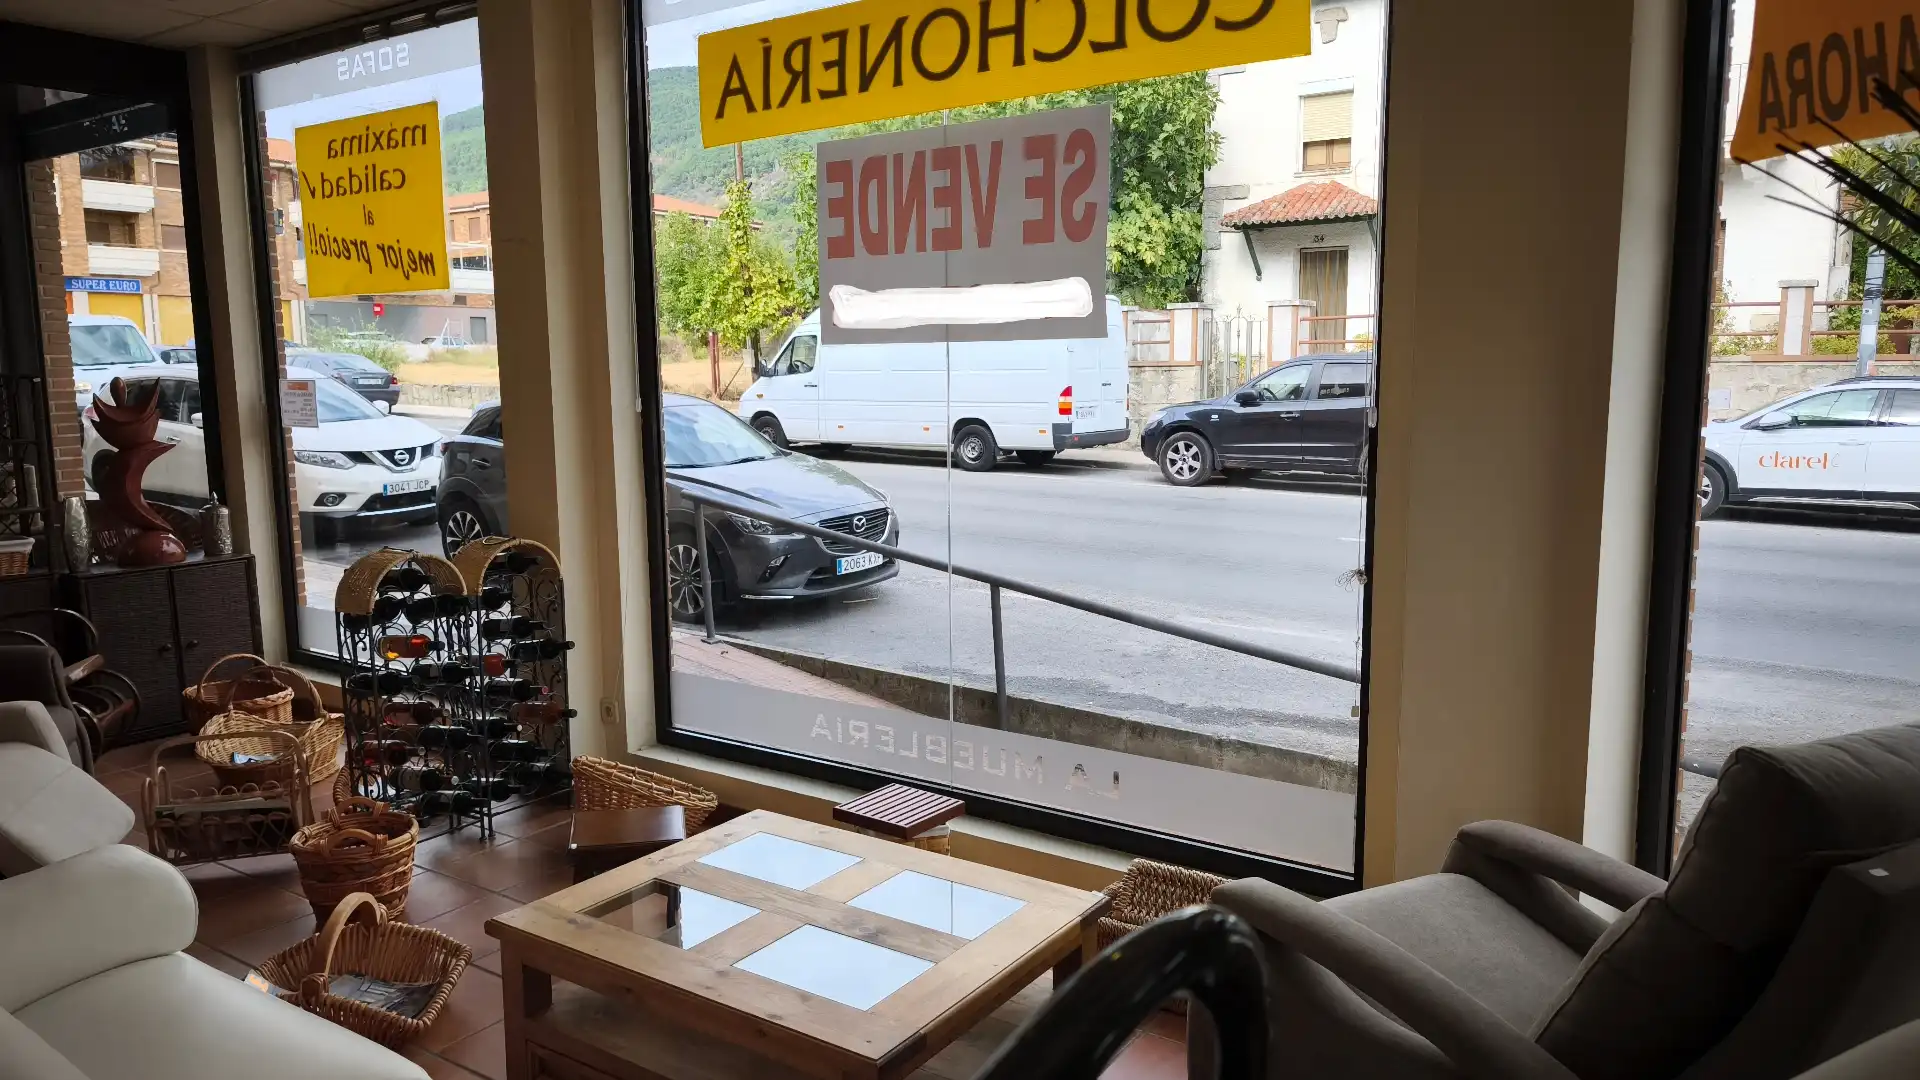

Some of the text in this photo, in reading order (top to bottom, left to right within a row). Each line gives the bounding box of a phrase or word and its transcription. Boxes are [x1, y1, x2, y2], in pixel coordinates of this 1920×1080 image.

[71, 278, 137, 292] SUPER EURO
[389, 482, 411, 493] 3041
[843, 556, 866, 572] 2063
